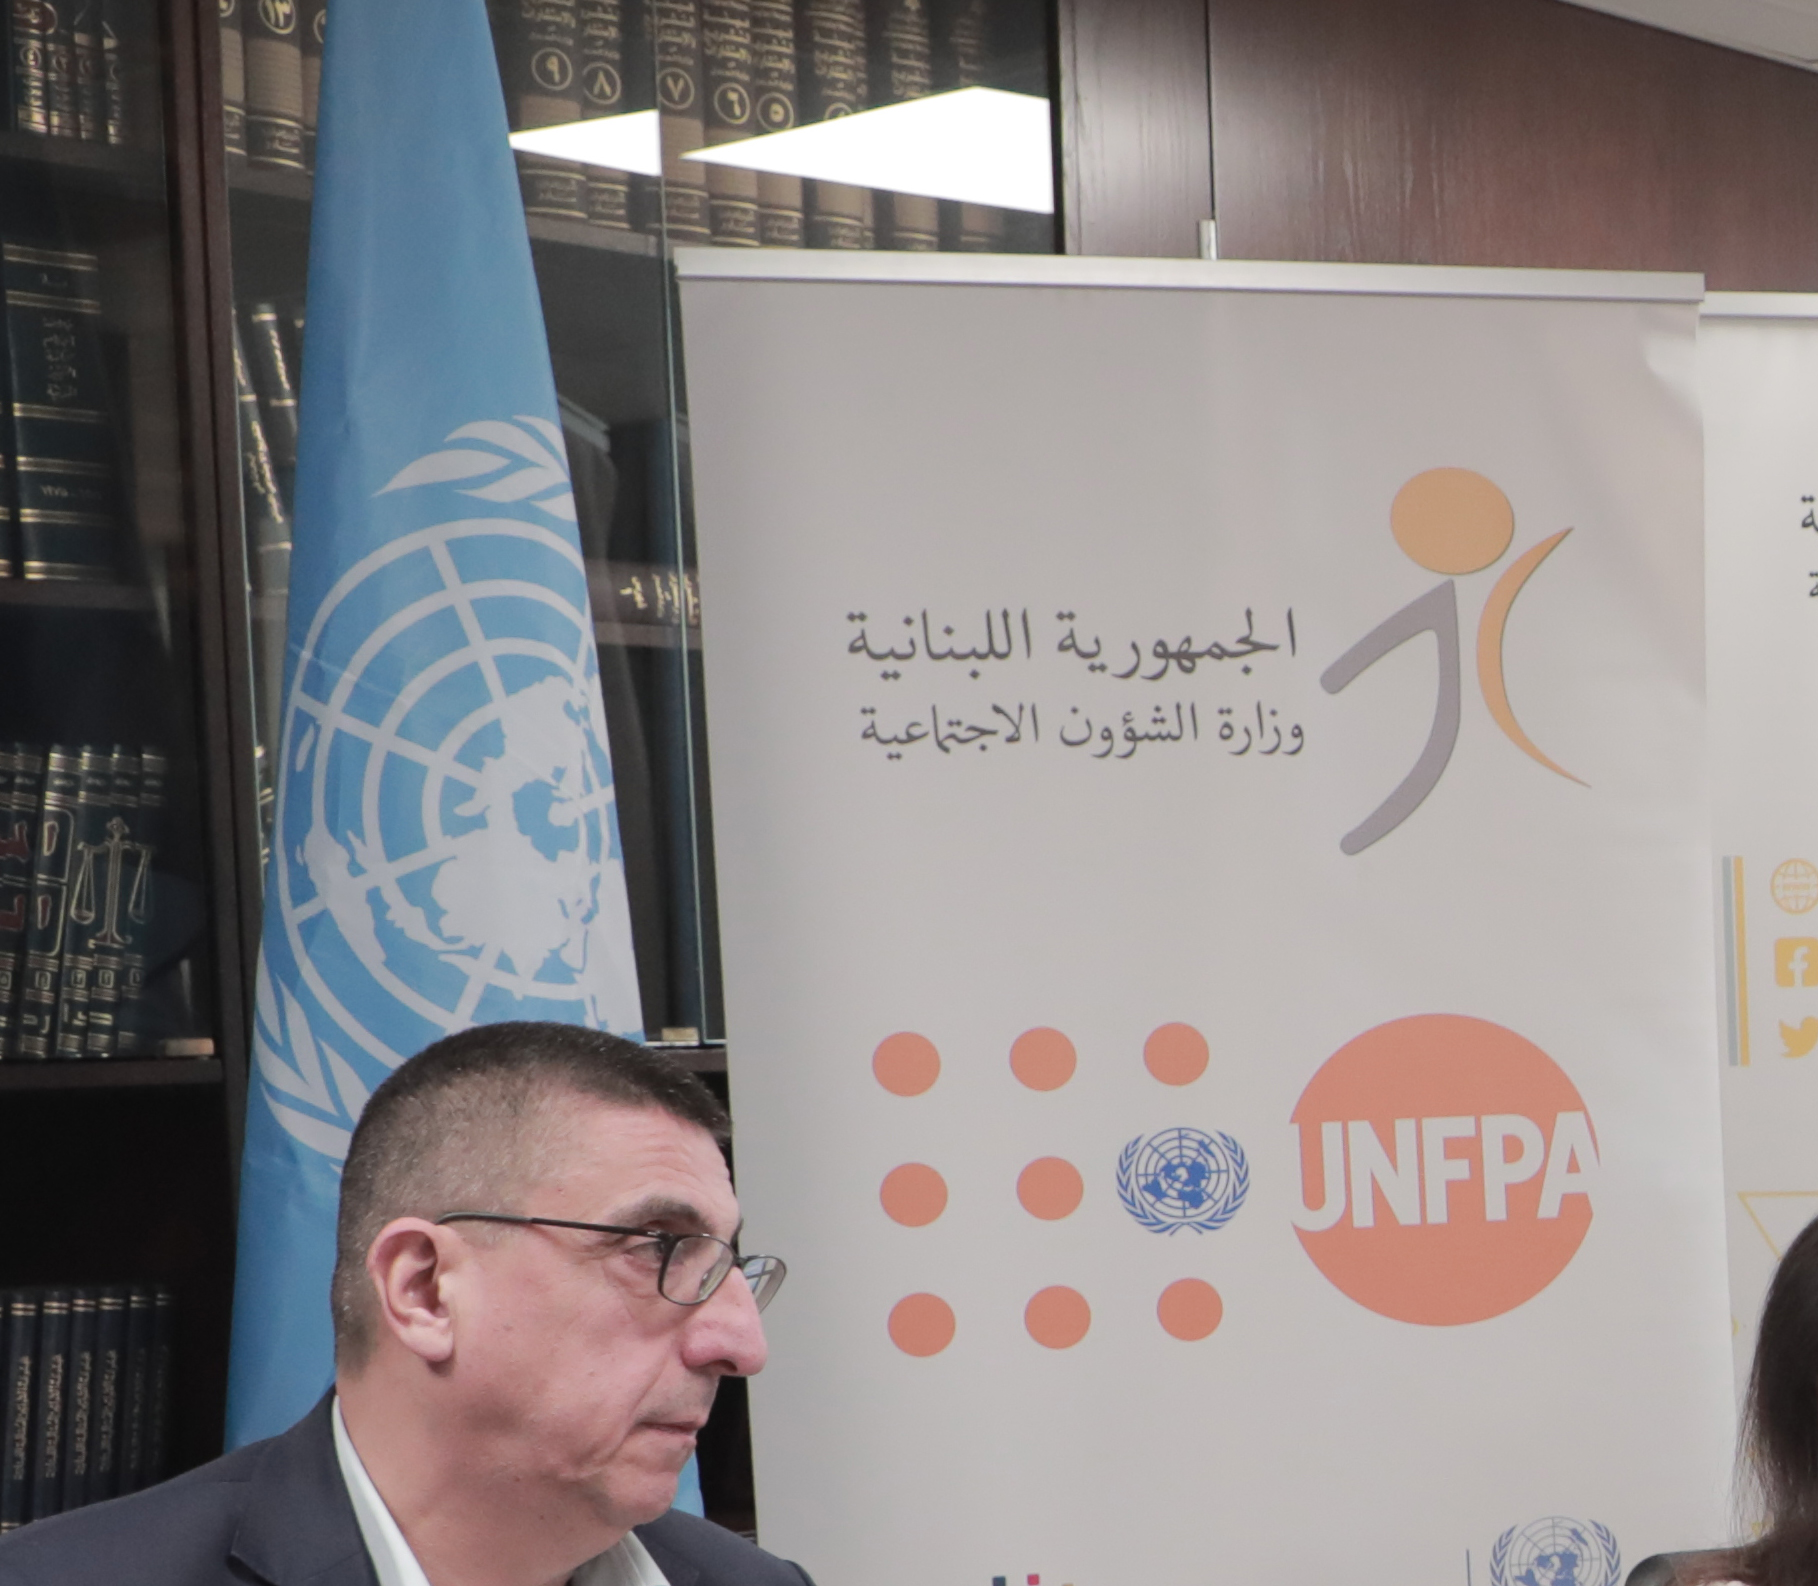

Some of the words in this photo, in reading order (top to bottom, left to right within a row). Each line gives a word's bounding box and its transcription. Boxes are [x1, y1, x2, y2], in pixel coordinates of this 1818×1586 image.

[847, 608, 1031, 680] اللبنانية
[1056, 608, 1296, 681] الجمهورية
[861, 703, 1038, 760] الاجتماعية
[1060, 702, 1197, 759] الشؤون
[1218, 701, 1304, 755] وزارة
[1288, 1110, 1601, 1233] UNFPA
